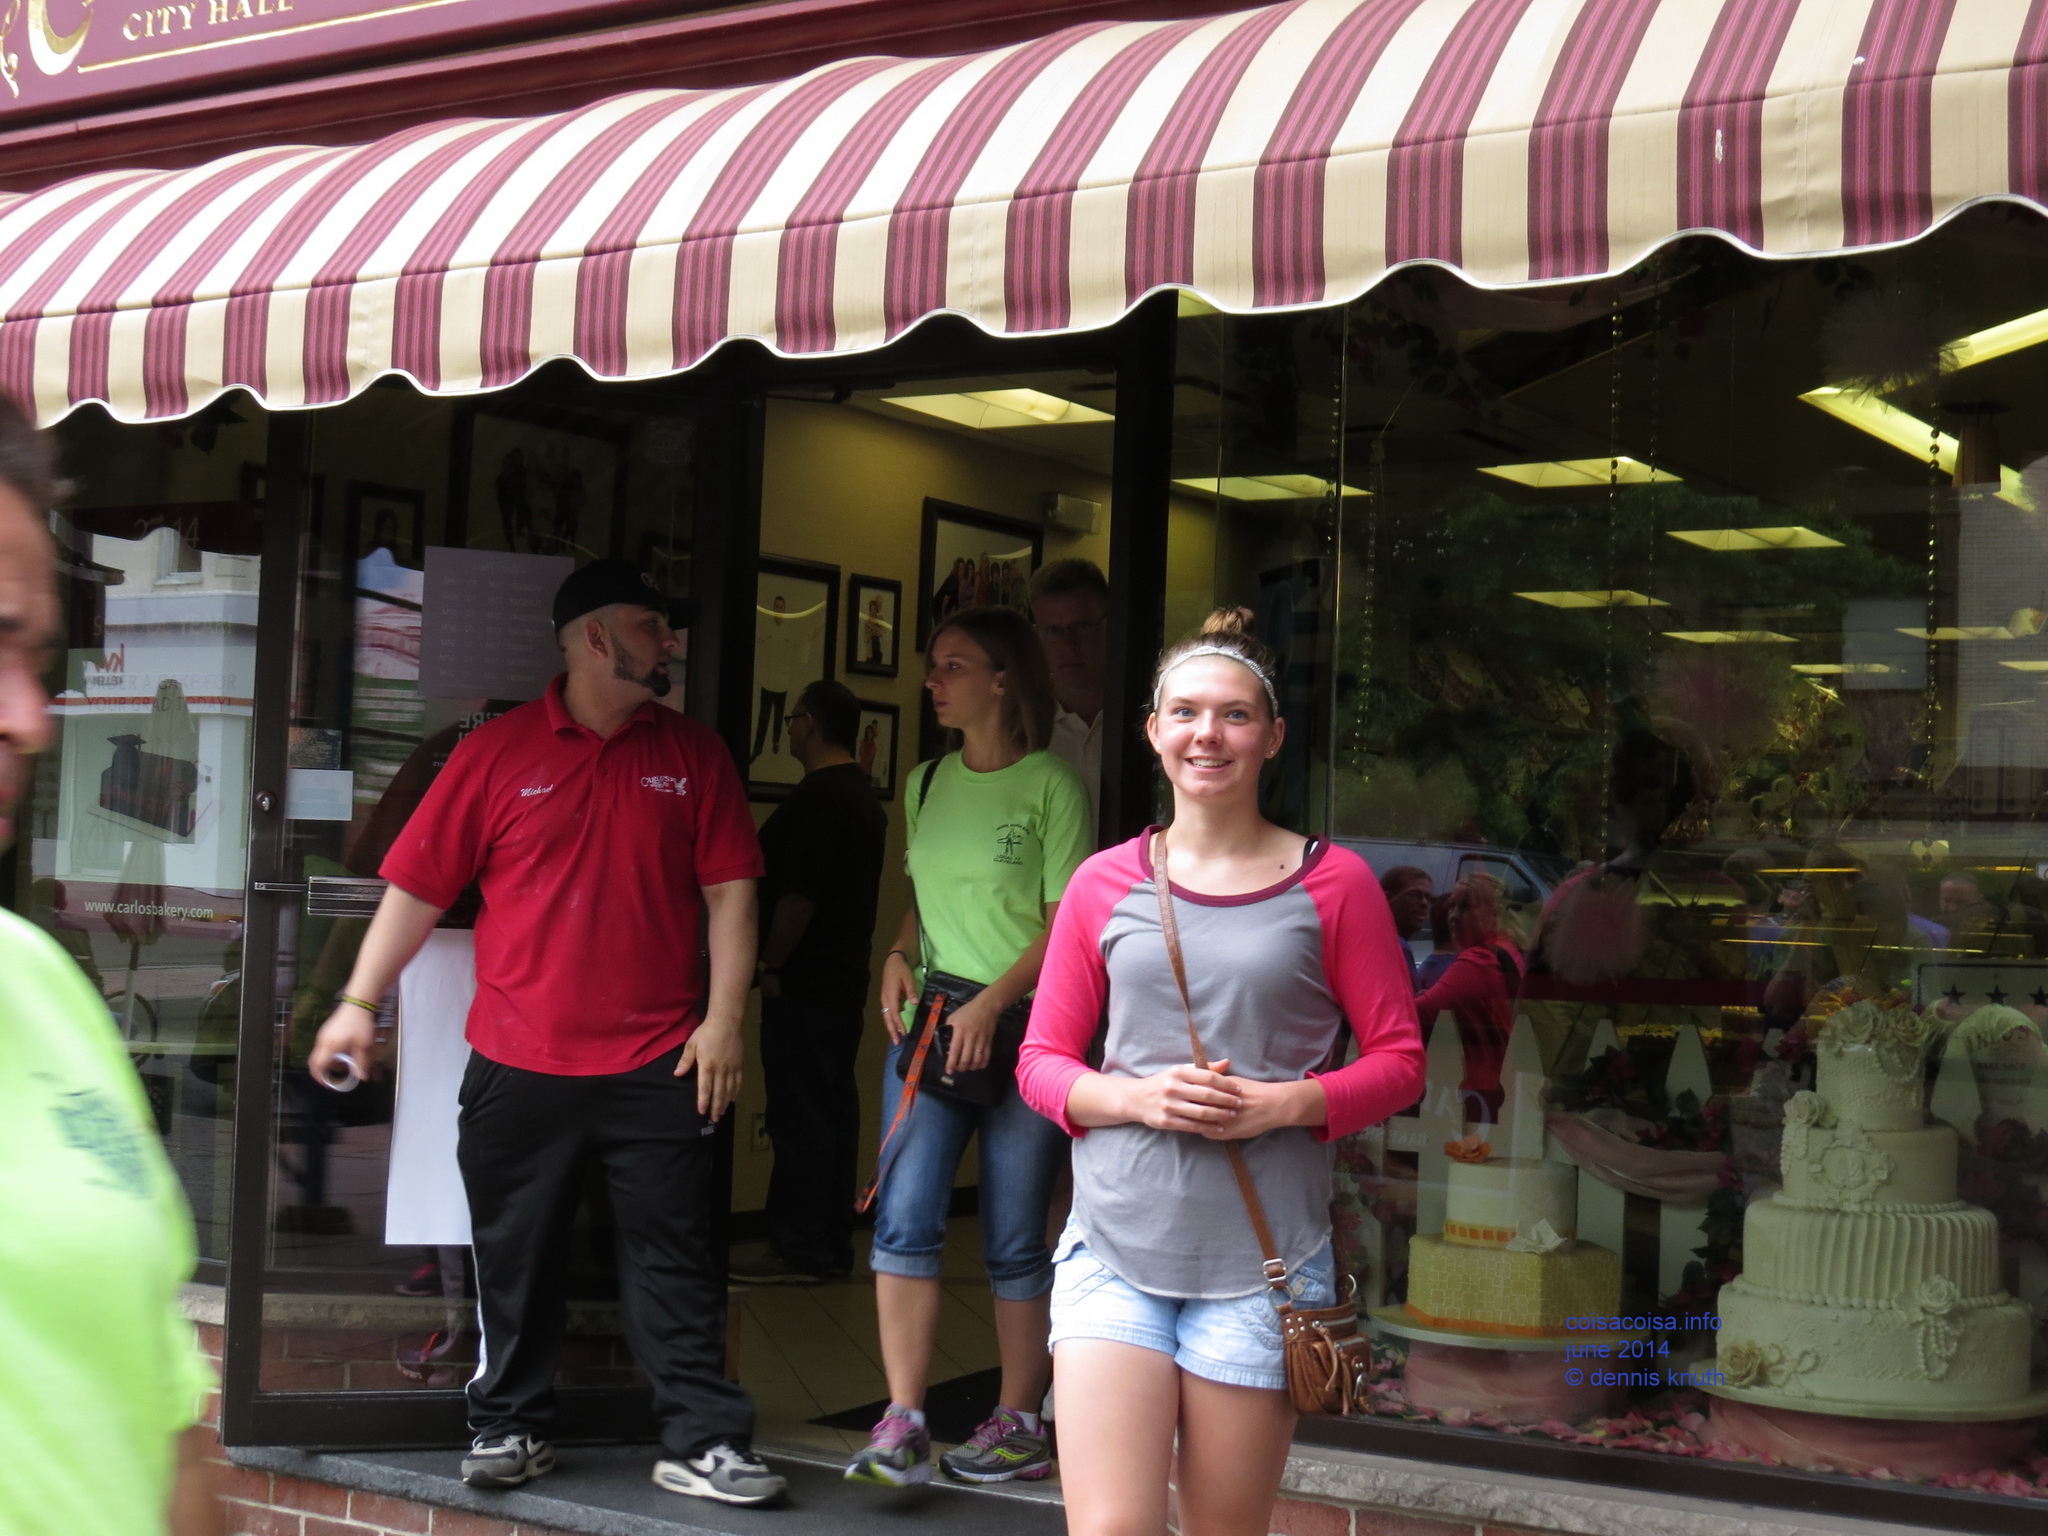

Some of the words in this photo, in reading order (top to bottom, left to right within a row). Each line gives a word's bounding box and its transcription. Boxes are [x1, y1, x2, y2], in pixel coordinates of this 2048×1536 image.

[122, 3, 195, 41] CITY
[134, 515, 200, 549] 214
[87, 696, 128, 711] YOUR
[132, 696, 171, 712] GRAD
[520, 784, 554, 797] Michael
[84, 899, 214, 921] www.carlosbakery.com
